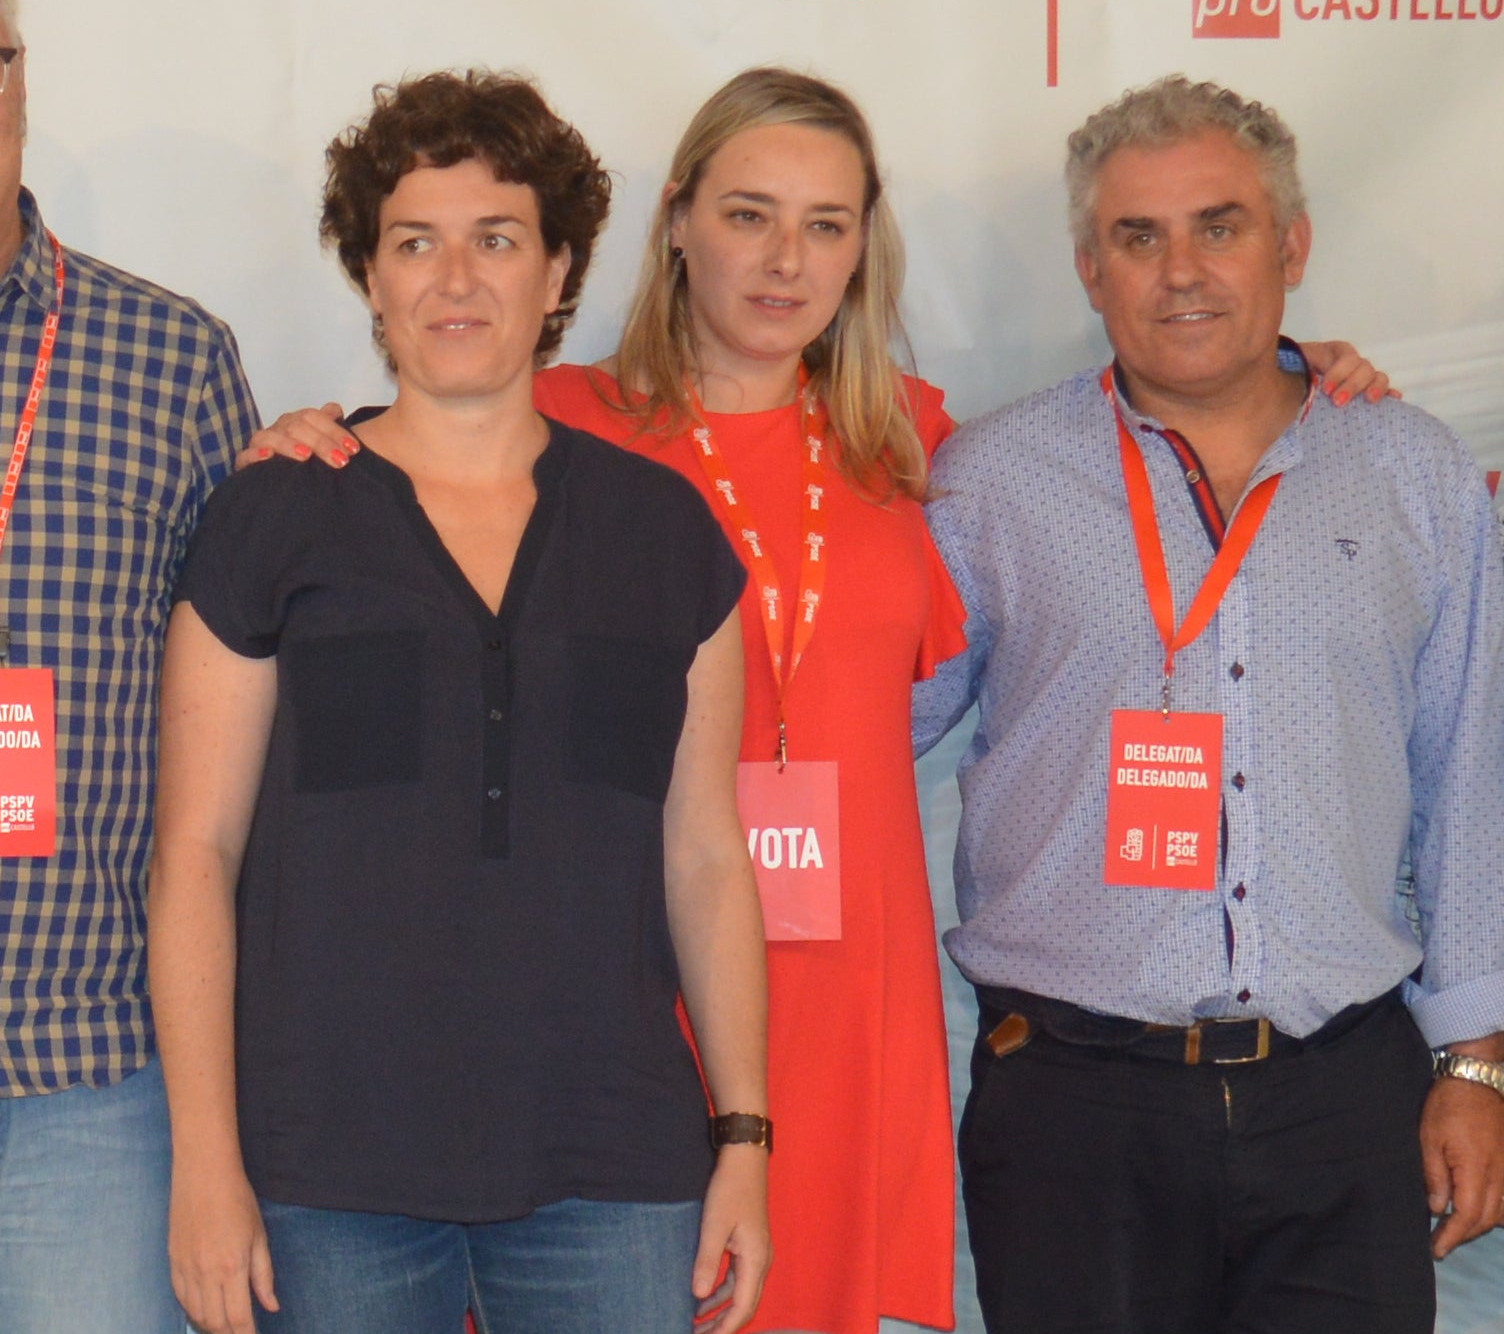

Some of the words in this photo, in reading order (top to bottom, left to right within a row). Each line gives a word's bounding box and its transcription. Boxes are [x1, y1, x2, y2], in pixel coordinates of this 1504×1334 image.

[1124, 743, 1203, 764] DELEGAT/DA
[1117, 768, 1208, 789] DELEGADO/DA
[0, 795, 35, 808] PSPV
[0, 809, 34, 822] PSOE
[1167, 831, 1199, 844] PSPV
[1166, 844, 1197, 857] PSOE
